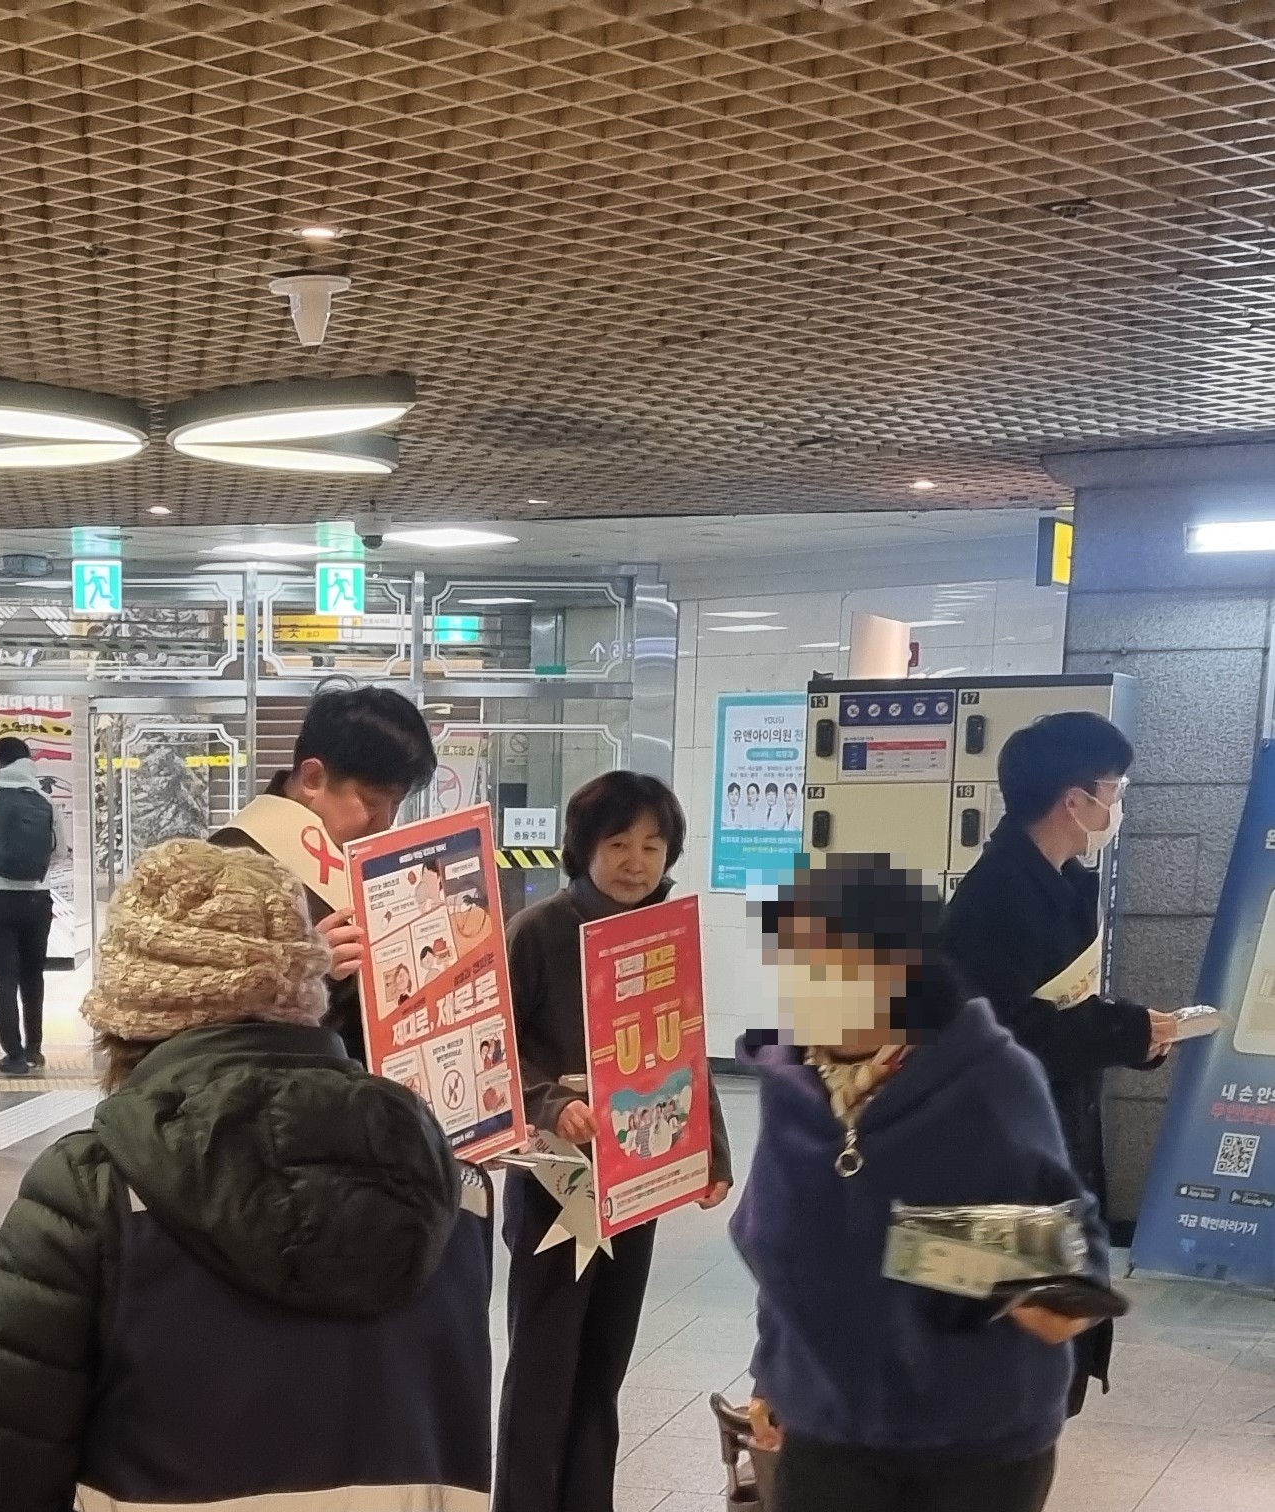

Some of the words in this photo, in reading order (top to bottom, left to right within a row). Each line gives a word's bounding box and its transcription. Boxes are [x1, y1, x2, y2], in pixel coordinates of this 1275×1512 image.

[812, 695, 827, 708] 13
[961, 692, 978, 704] 17
[809, 788, 824, 799] 14
[957, 786, 974, 798] 18
[952, 879, 963, 891] 1
[1221, 1084, 1237, 1101] 내
[1238, 1086, 1254, 1103] 손
[1178, 1213, 1198, 1228] 지금
[1199, 1216, 1259, 1236] 확인하러가기
